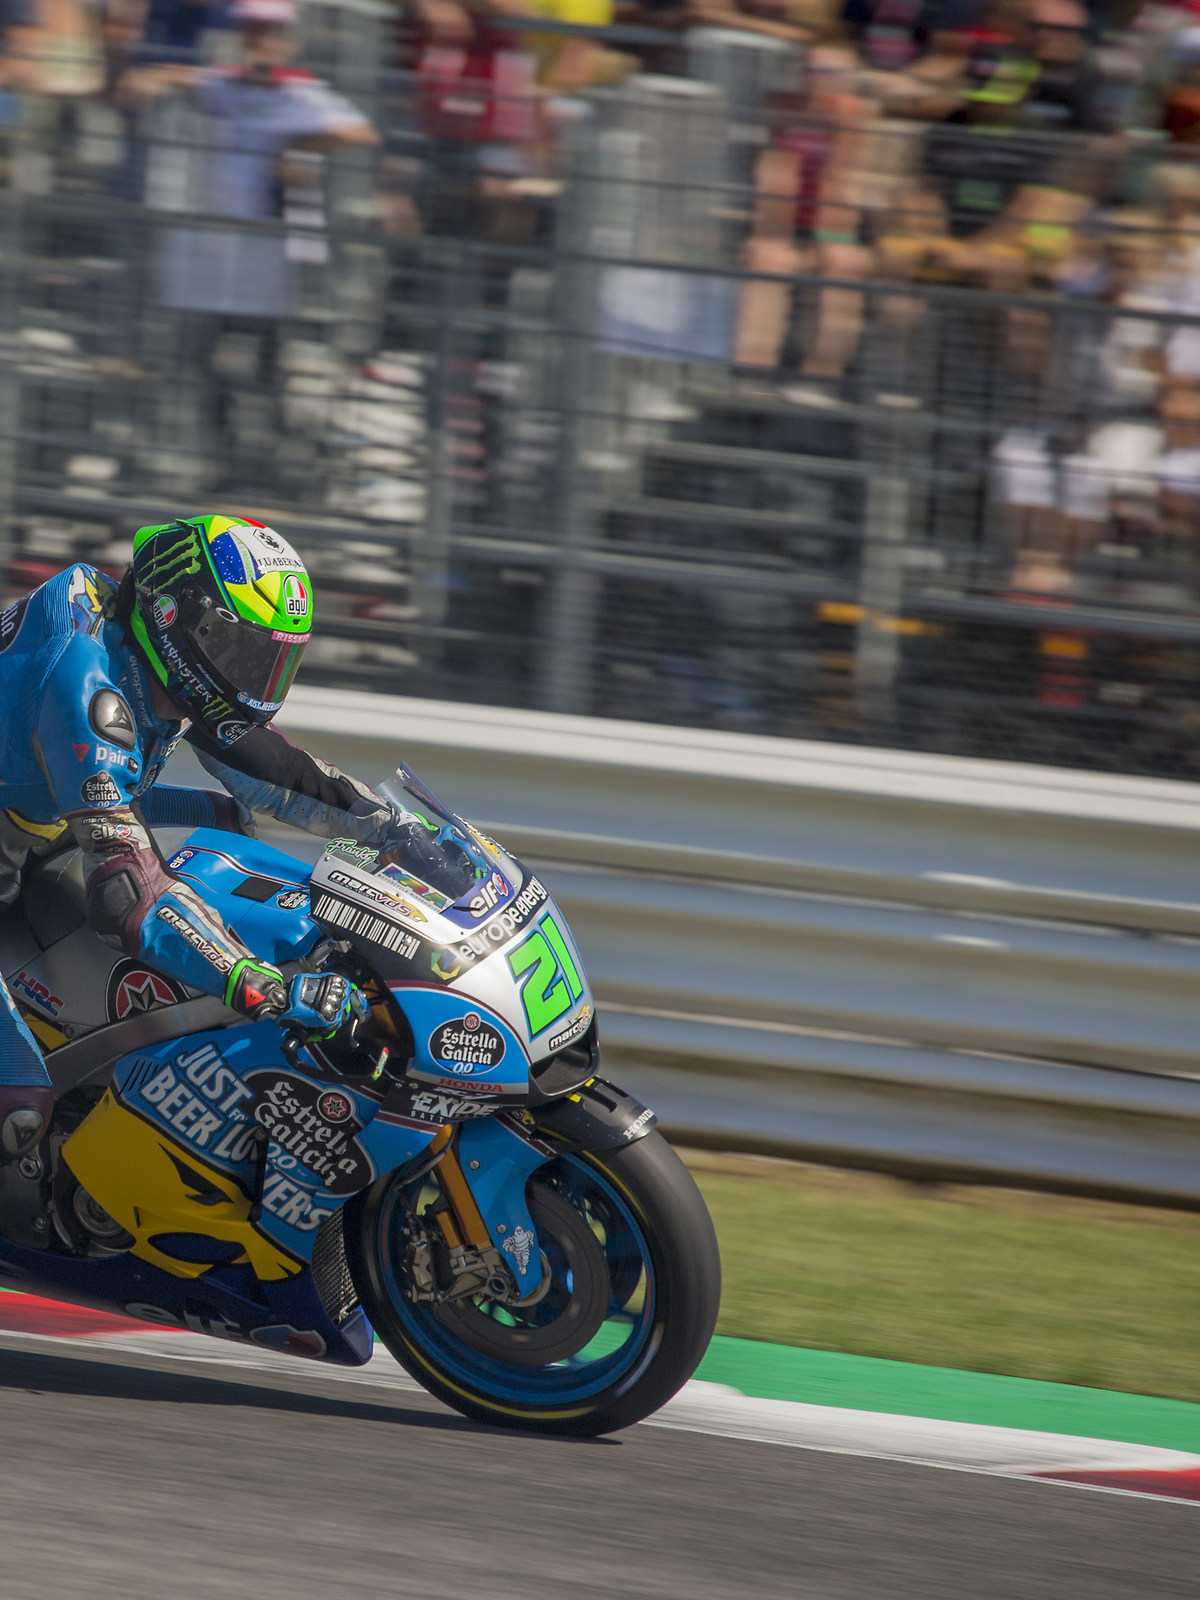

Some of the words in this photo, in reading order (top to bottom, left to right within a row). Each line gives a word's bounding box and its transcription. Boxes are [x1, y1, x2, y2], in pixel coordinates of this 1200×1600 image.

[160, 634, 213, 703] MONSTER
[459, 906, 523, 962] europe
[515, 875, 548, 916] energy
[469, 880, 500, 918] elf
[506, 912, 585, 1040] 21
[440, 1026, 498, 1050] Estrella
[441, 1044, 492, 1065] Galicia
[177, 1044, 253, 1112] JUST
[410, 1091, 500, 1118] EXIDE
[438, 1077, 505, 1093] HONDA
[141, 1065, 223, 1147] BEER
